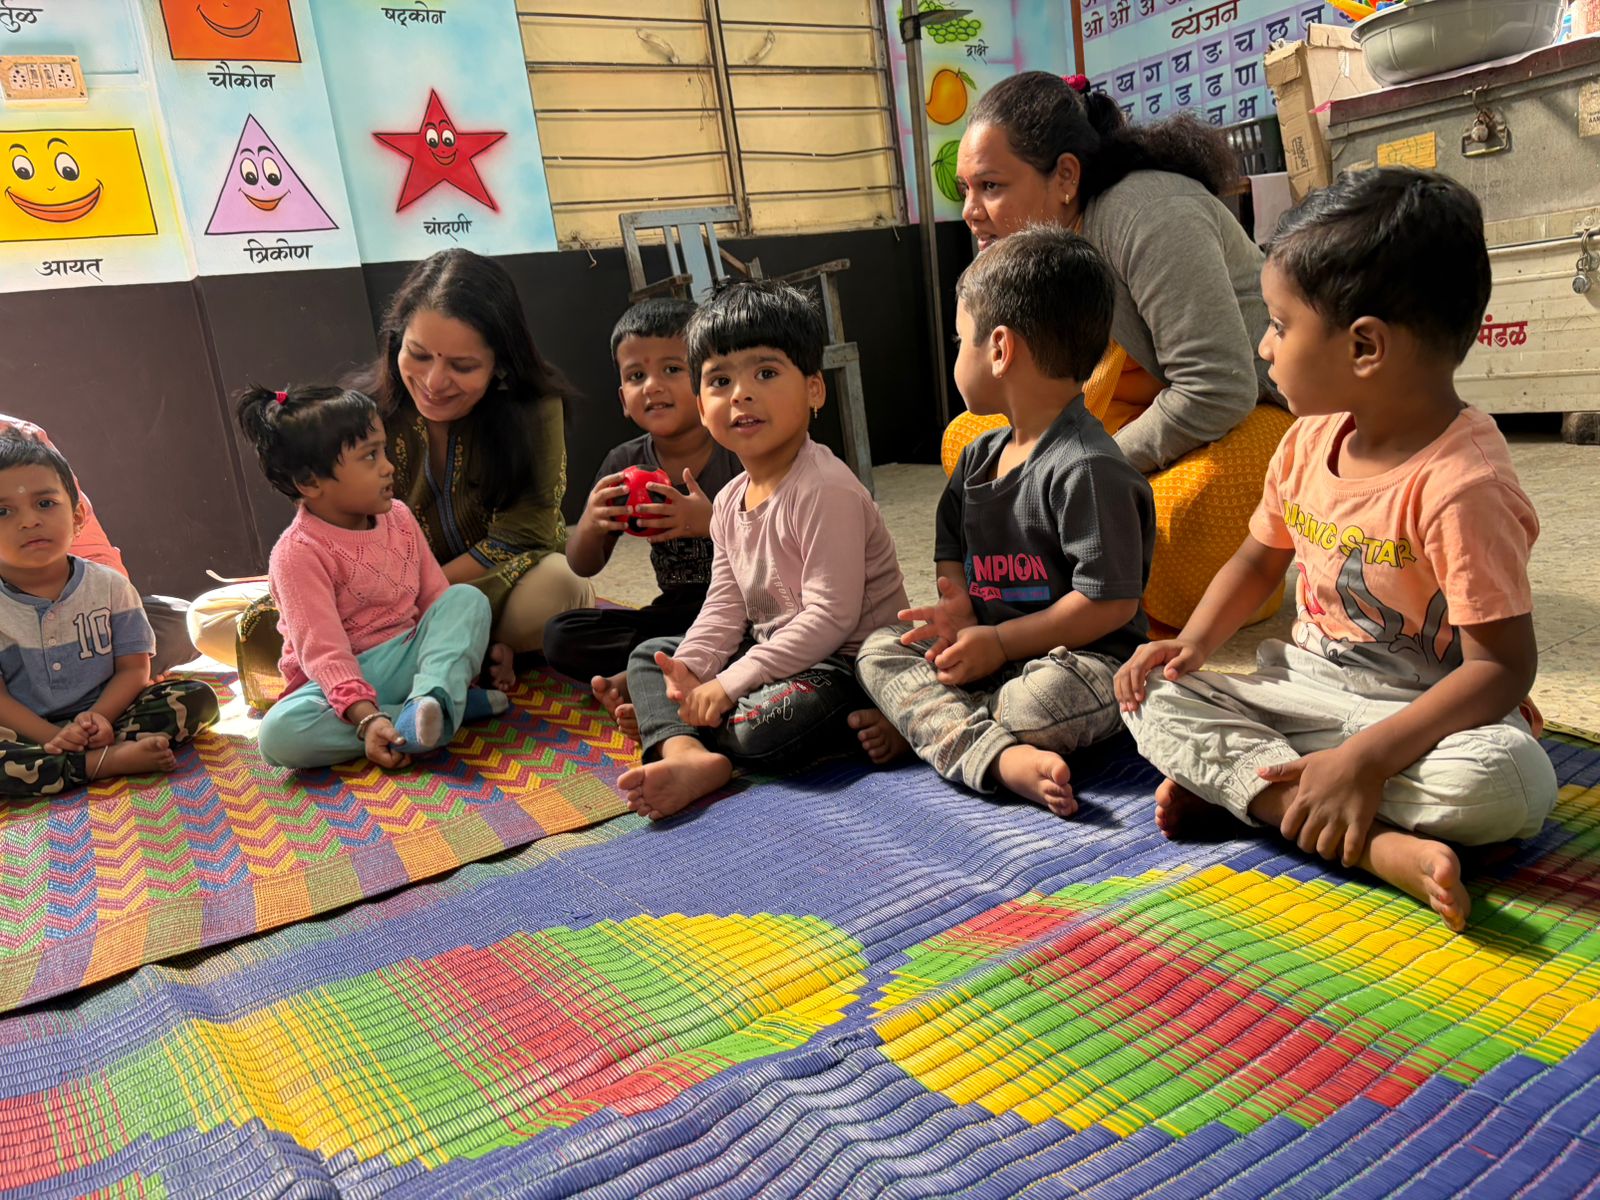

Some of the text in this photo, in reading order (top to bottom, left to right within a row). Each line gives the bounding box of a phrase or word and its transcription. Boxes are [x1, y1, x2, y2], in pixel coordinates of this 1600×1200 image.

[1171, 0, 1240, 39] व्यंजन
[1116, 71, 1136, 92] ख
[1143, 61, 1163, 82] ग
[1171, 50, 1192, 73] घ
[1233, 28, 1256, 52] च
[1265, 16, 1290, 43] छ
[207, 61, 276, 91] चौकोन
[1146, 93, 1162, 114] ठ
[1175, 83, 1192, 106] ड
[1205, 73, 1224, 97] ढ
[1235, 61, 1257, 86] ण
[1238, 95, 1258, 118] भ
[423, 213, 473, 242] चांदणी
[243, 238, 313, 264] त्रिकोण
[35, 258, 104, 282] आयत
[1477, 314, 1528, 347] मंडळ
[1338, 525, 1417, 568] STAR
[73, 607, 112, 660] 10
